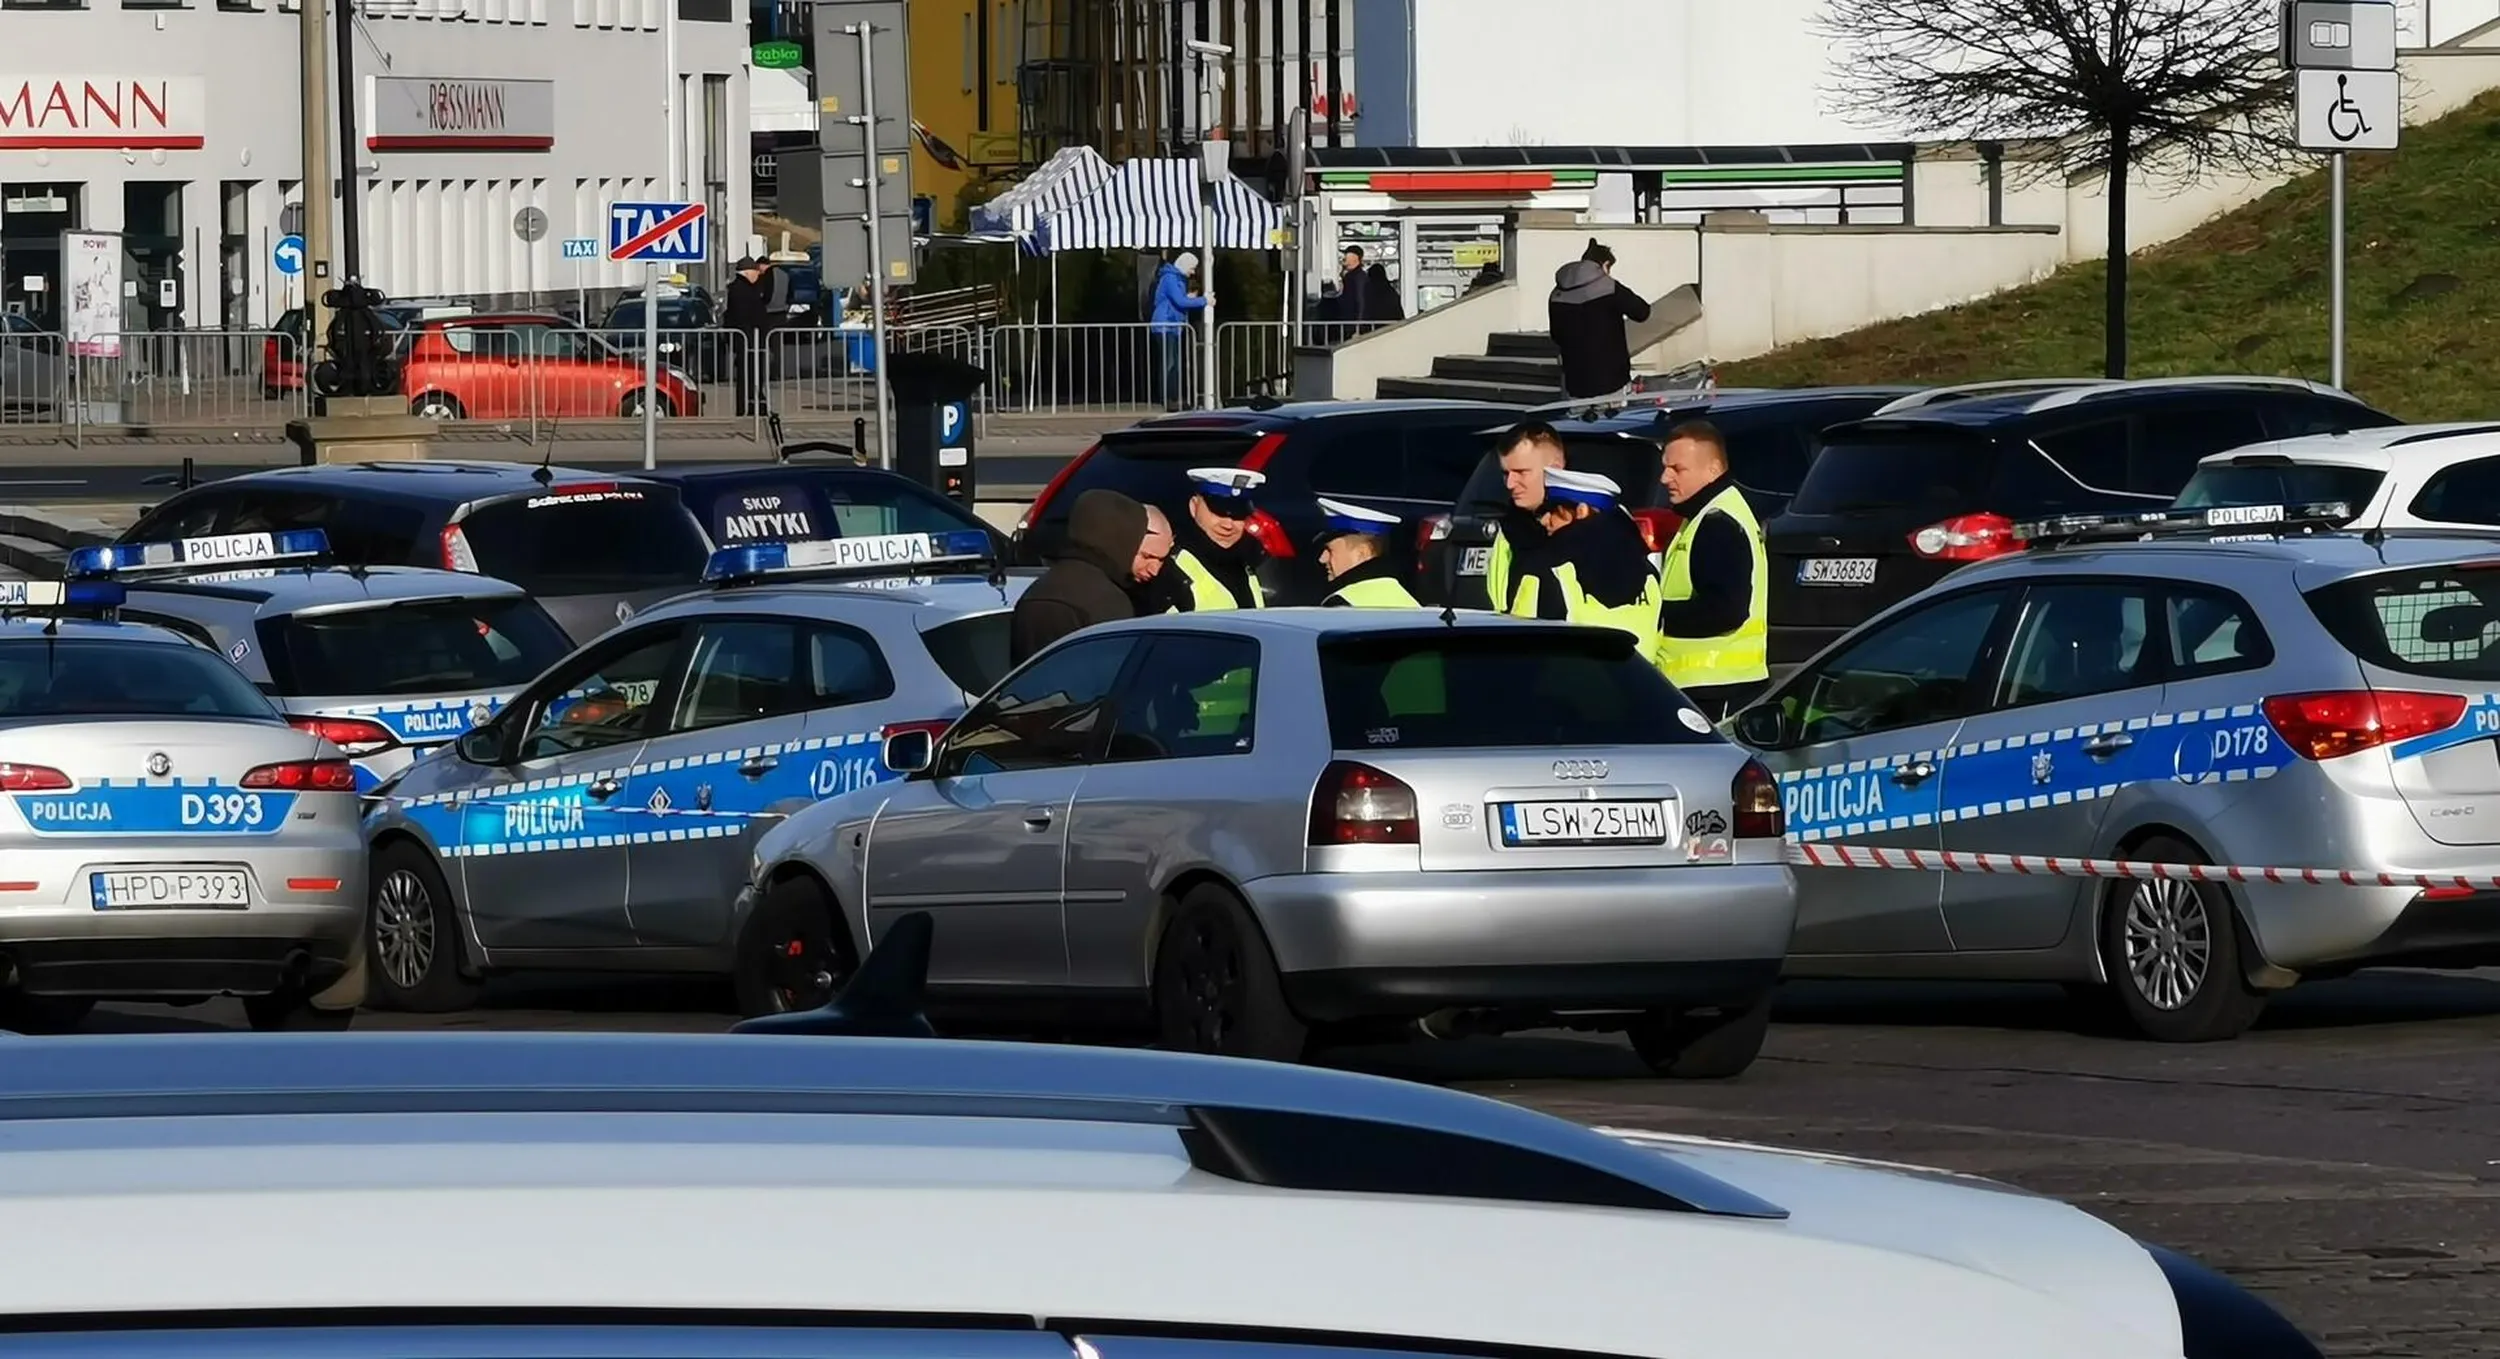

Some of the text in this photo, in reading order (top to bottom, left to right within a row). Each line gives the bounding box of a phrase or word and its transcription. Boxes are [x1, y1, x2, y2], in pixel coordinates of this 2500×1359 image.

[429, 82, 505, 130] ROSSMANN
[613, 209, 699, 253] TAXI
[564, 241, 597, 257] TAXI
[943, 405, 959, 437] P
[742, 496, 781, 511] SKUP
[2211, 507, 2280, 524] POLICJA
[725, 511, 810, 539] ANTYKI
[190, 537, 268, 561] POLICJA
[839, 538, 925, 564] POLICJA
[1831, 560, 1875, 580] 36836
[403, 710, 462, 733] POLICJA
[2214, 725, 2268, 759] D178
[818, 757, 877, 795] D116
[31, 801, 113, 821] POLICJA
[181, 793, 263, 825] D393
[1785, 773, 1884, 827] POLICJA
[504, 794, 584, 838] POLICJA
[1523, 807, 1581, 836] LSW
[1591, 807, 1659, 837] 25HM
[110, 875, 241, 901] HPD P393
